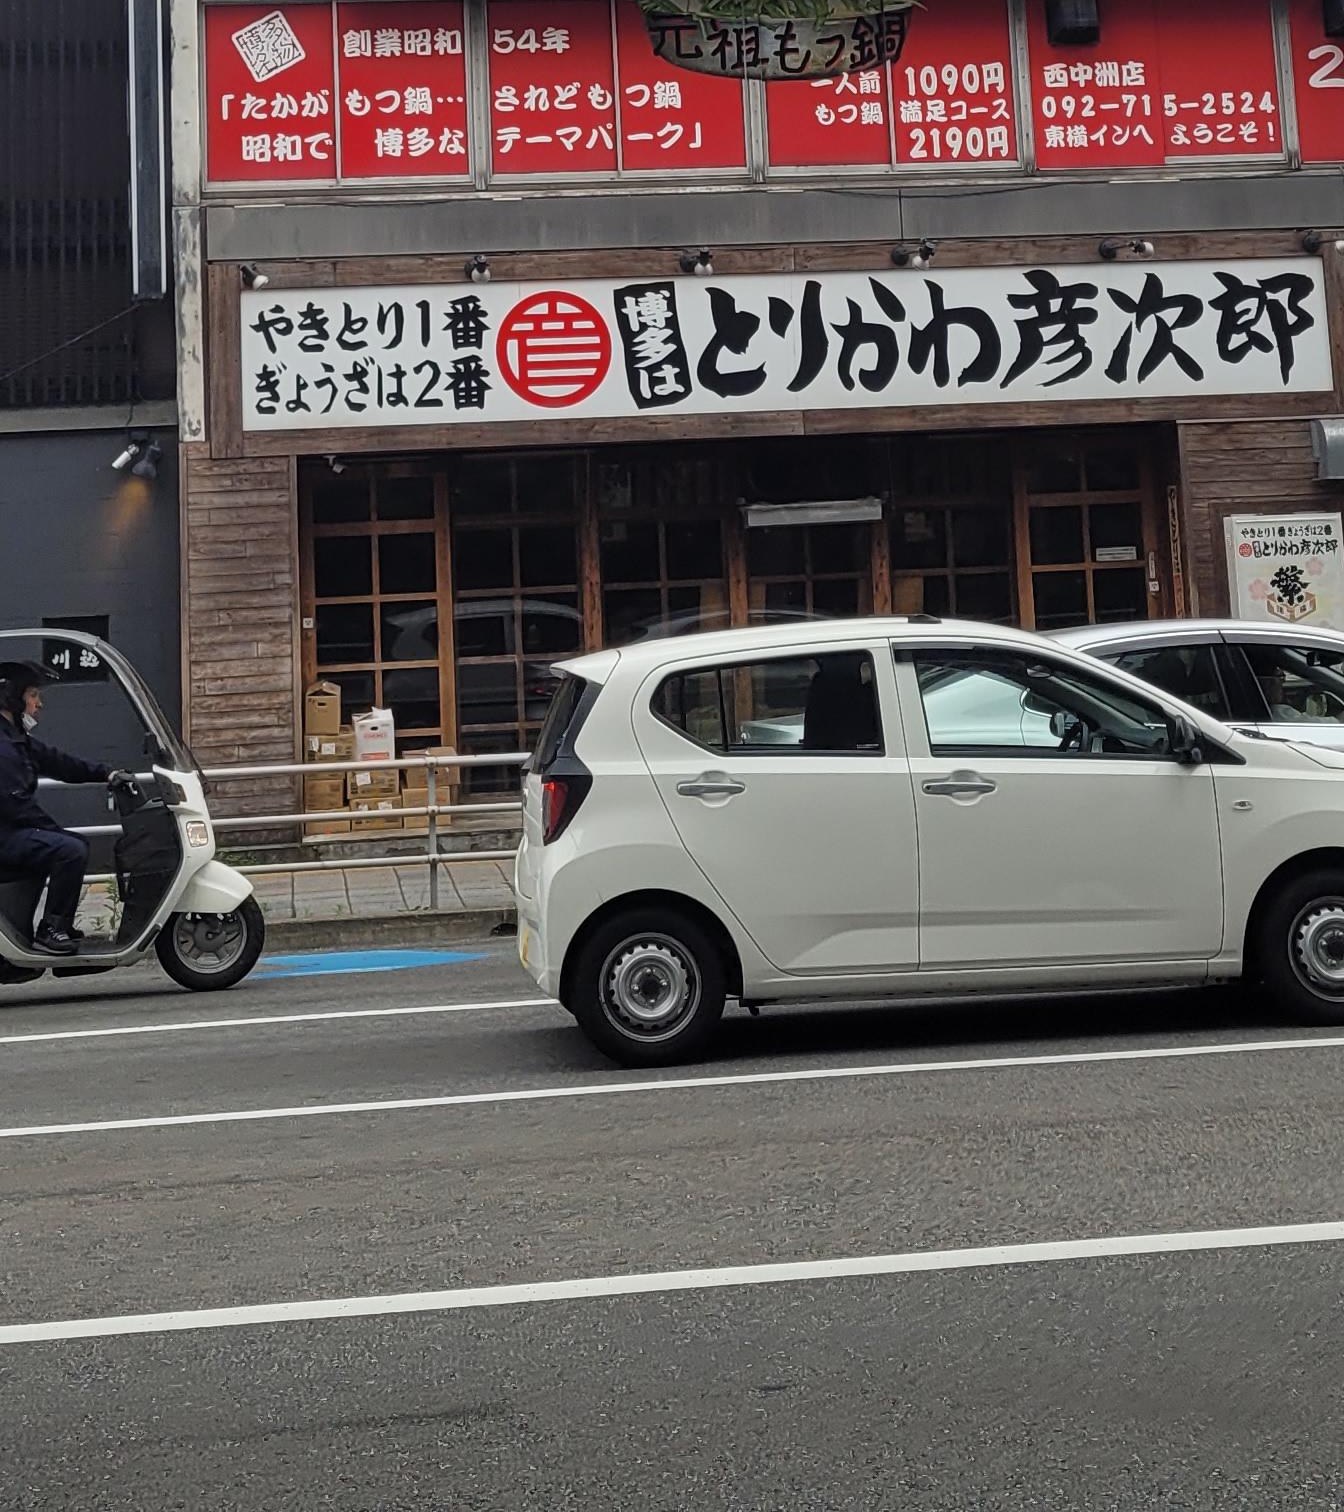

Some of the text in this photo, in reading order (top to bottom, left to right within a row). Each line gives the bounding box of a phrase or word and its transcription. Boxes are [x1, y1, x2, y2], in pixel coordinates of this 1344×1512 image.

[810, 61, 1006, 98] 一人前 1090円
[1043, 61, 1146, 88] 西中洲店
[814, 97, 1011, 126] もつ鍋 満足コース
[909, 126, 1009, 159] 2190円
[249, 294, 492, 354] やきとり1番
[696, 269, 1315, 399] とりかわ彦次郎
[253, 354, 494, 415] ぎょうざは2番
